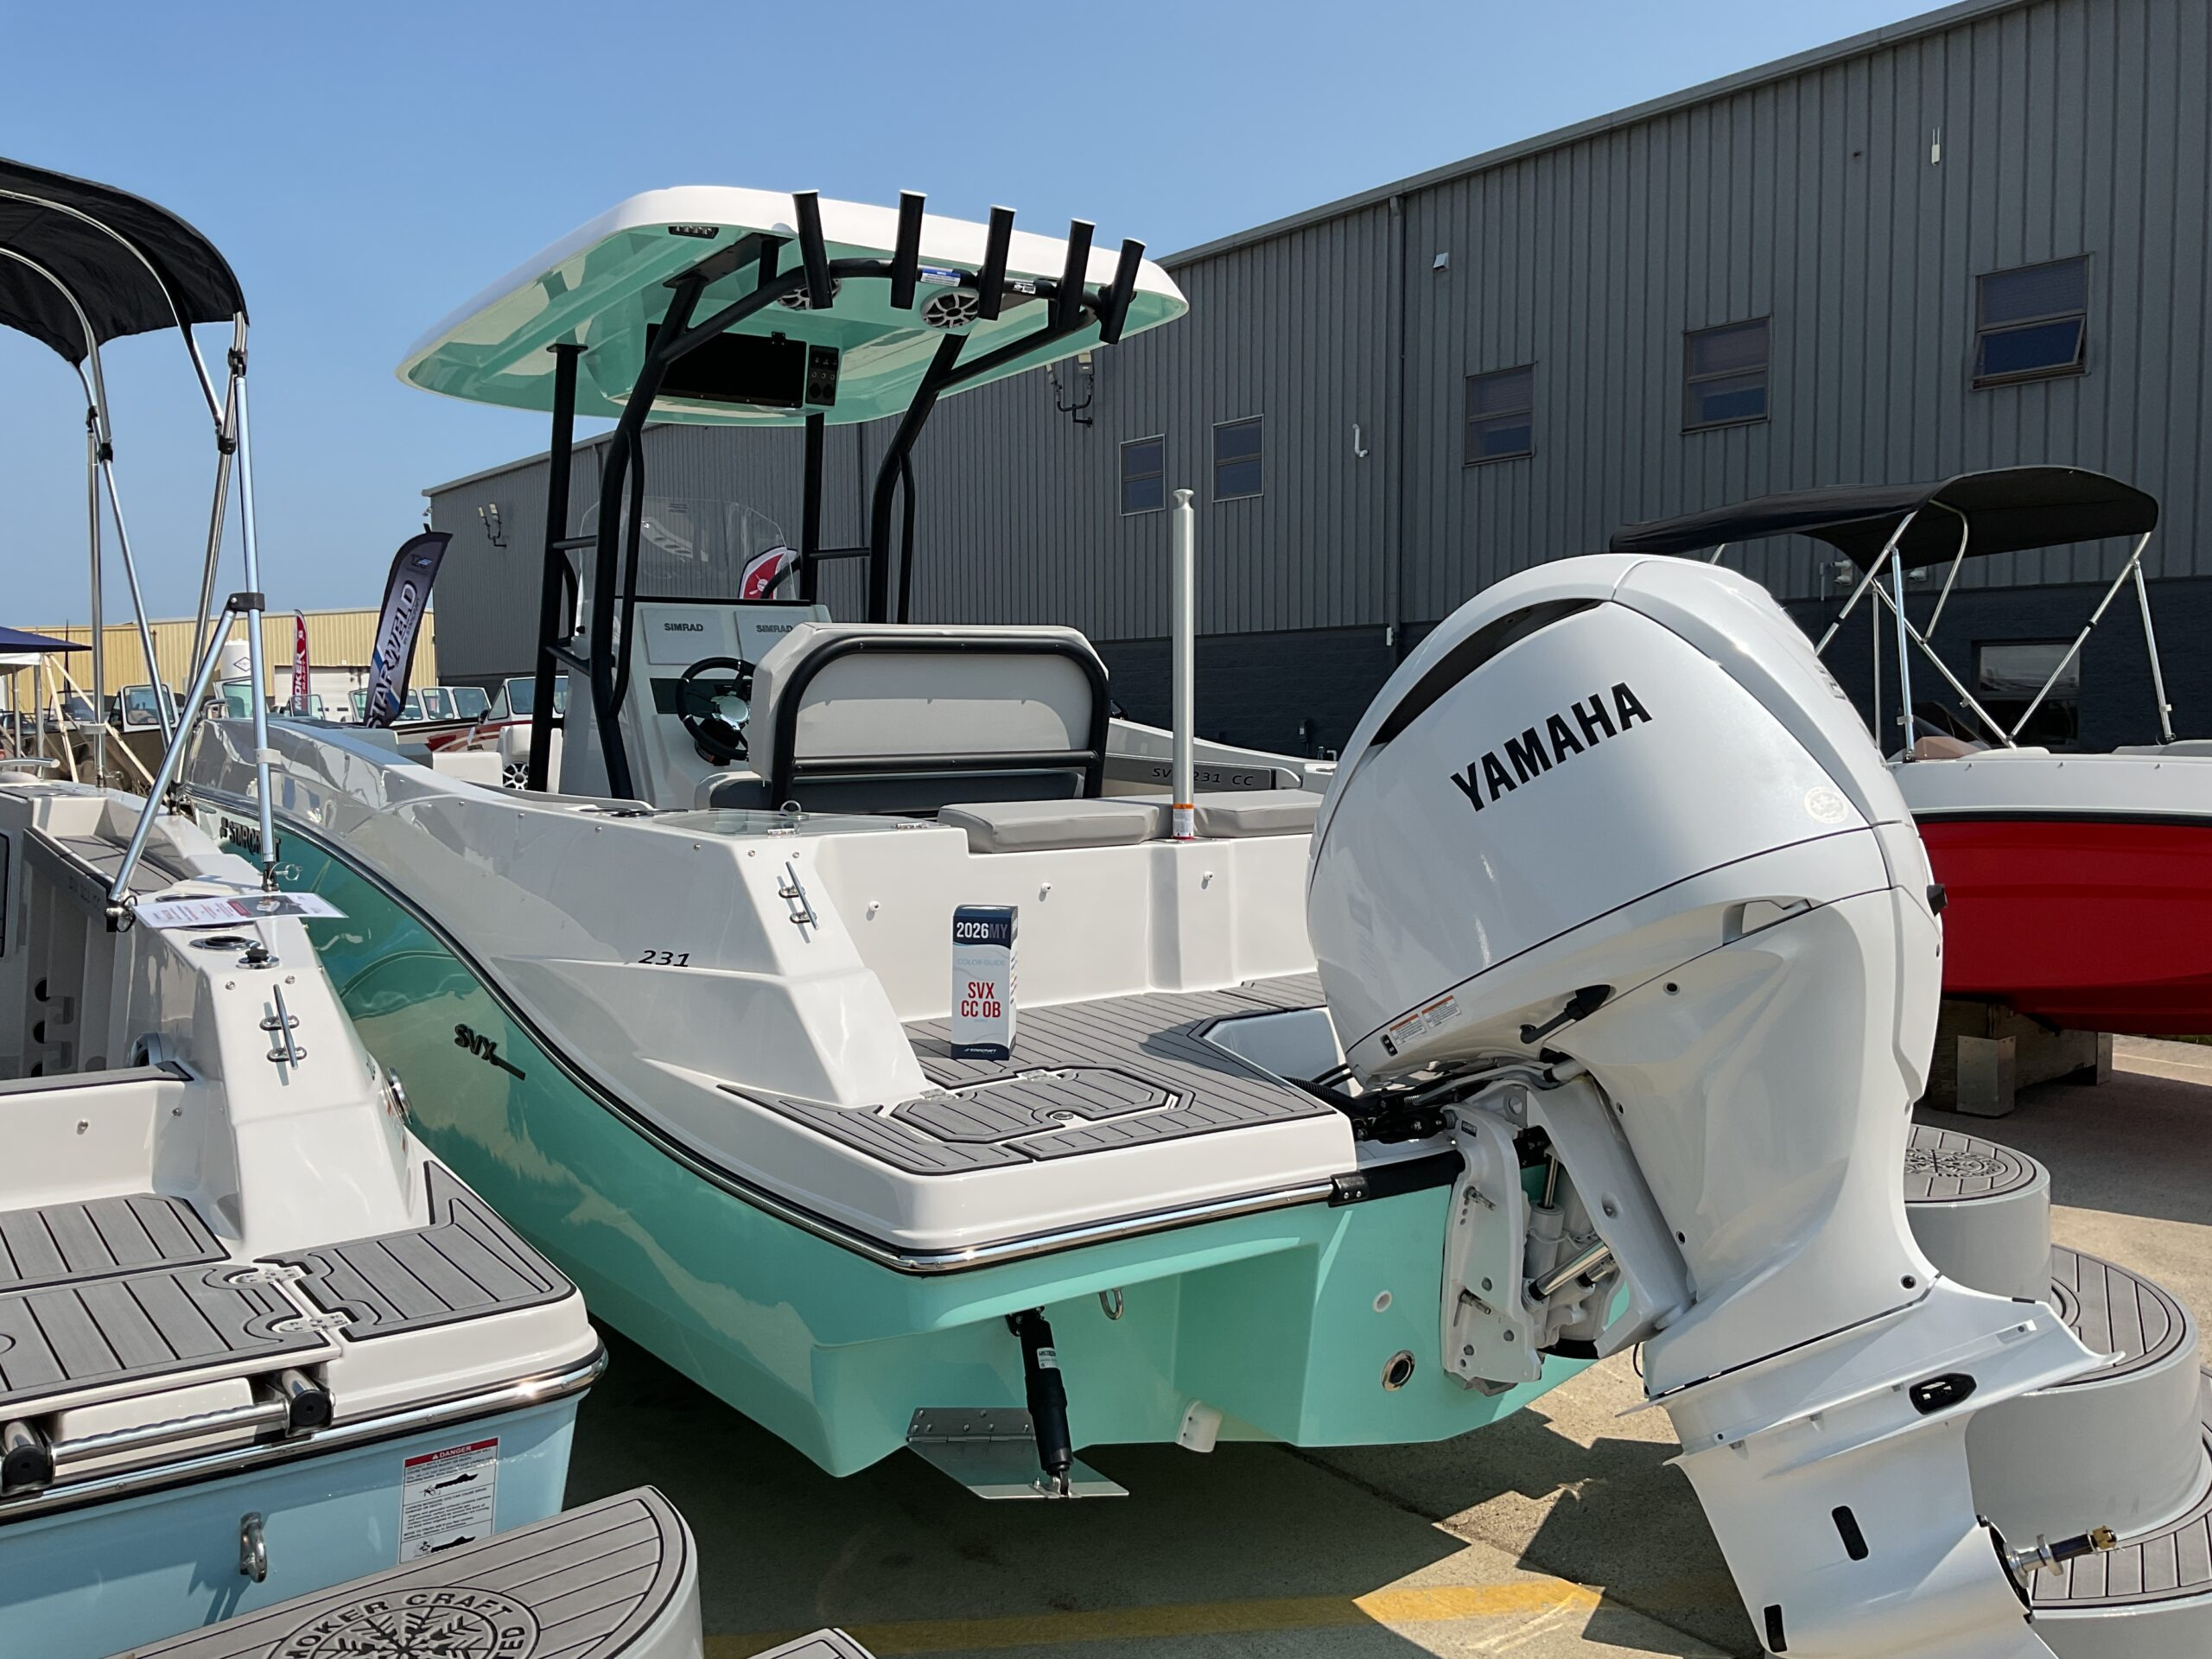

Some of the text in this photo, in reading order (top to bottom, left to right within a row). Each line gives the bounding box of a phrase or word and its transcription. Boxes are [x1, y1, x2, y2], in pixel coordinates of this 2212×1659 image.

[664, 622, 704, 632] SIMRAD
[756, 624, 793, 633] SIMRAD
[1449, 682, 1653, 812] YAMAHA
[1152, 767, 1255, 786] SV 231 CC
[227, 821, 282, 862] STARCRT
[956, 921, 1008, 939] 2026MY
[638, 950, 690, 968] 231
[968, 982, 995, 999] SVX
[961, 1000, 1001, 1018] CC OB
[439, 1446, 473, 1459] DANGER
[285, 1592, 513, 1659] MOKER CRAFT
